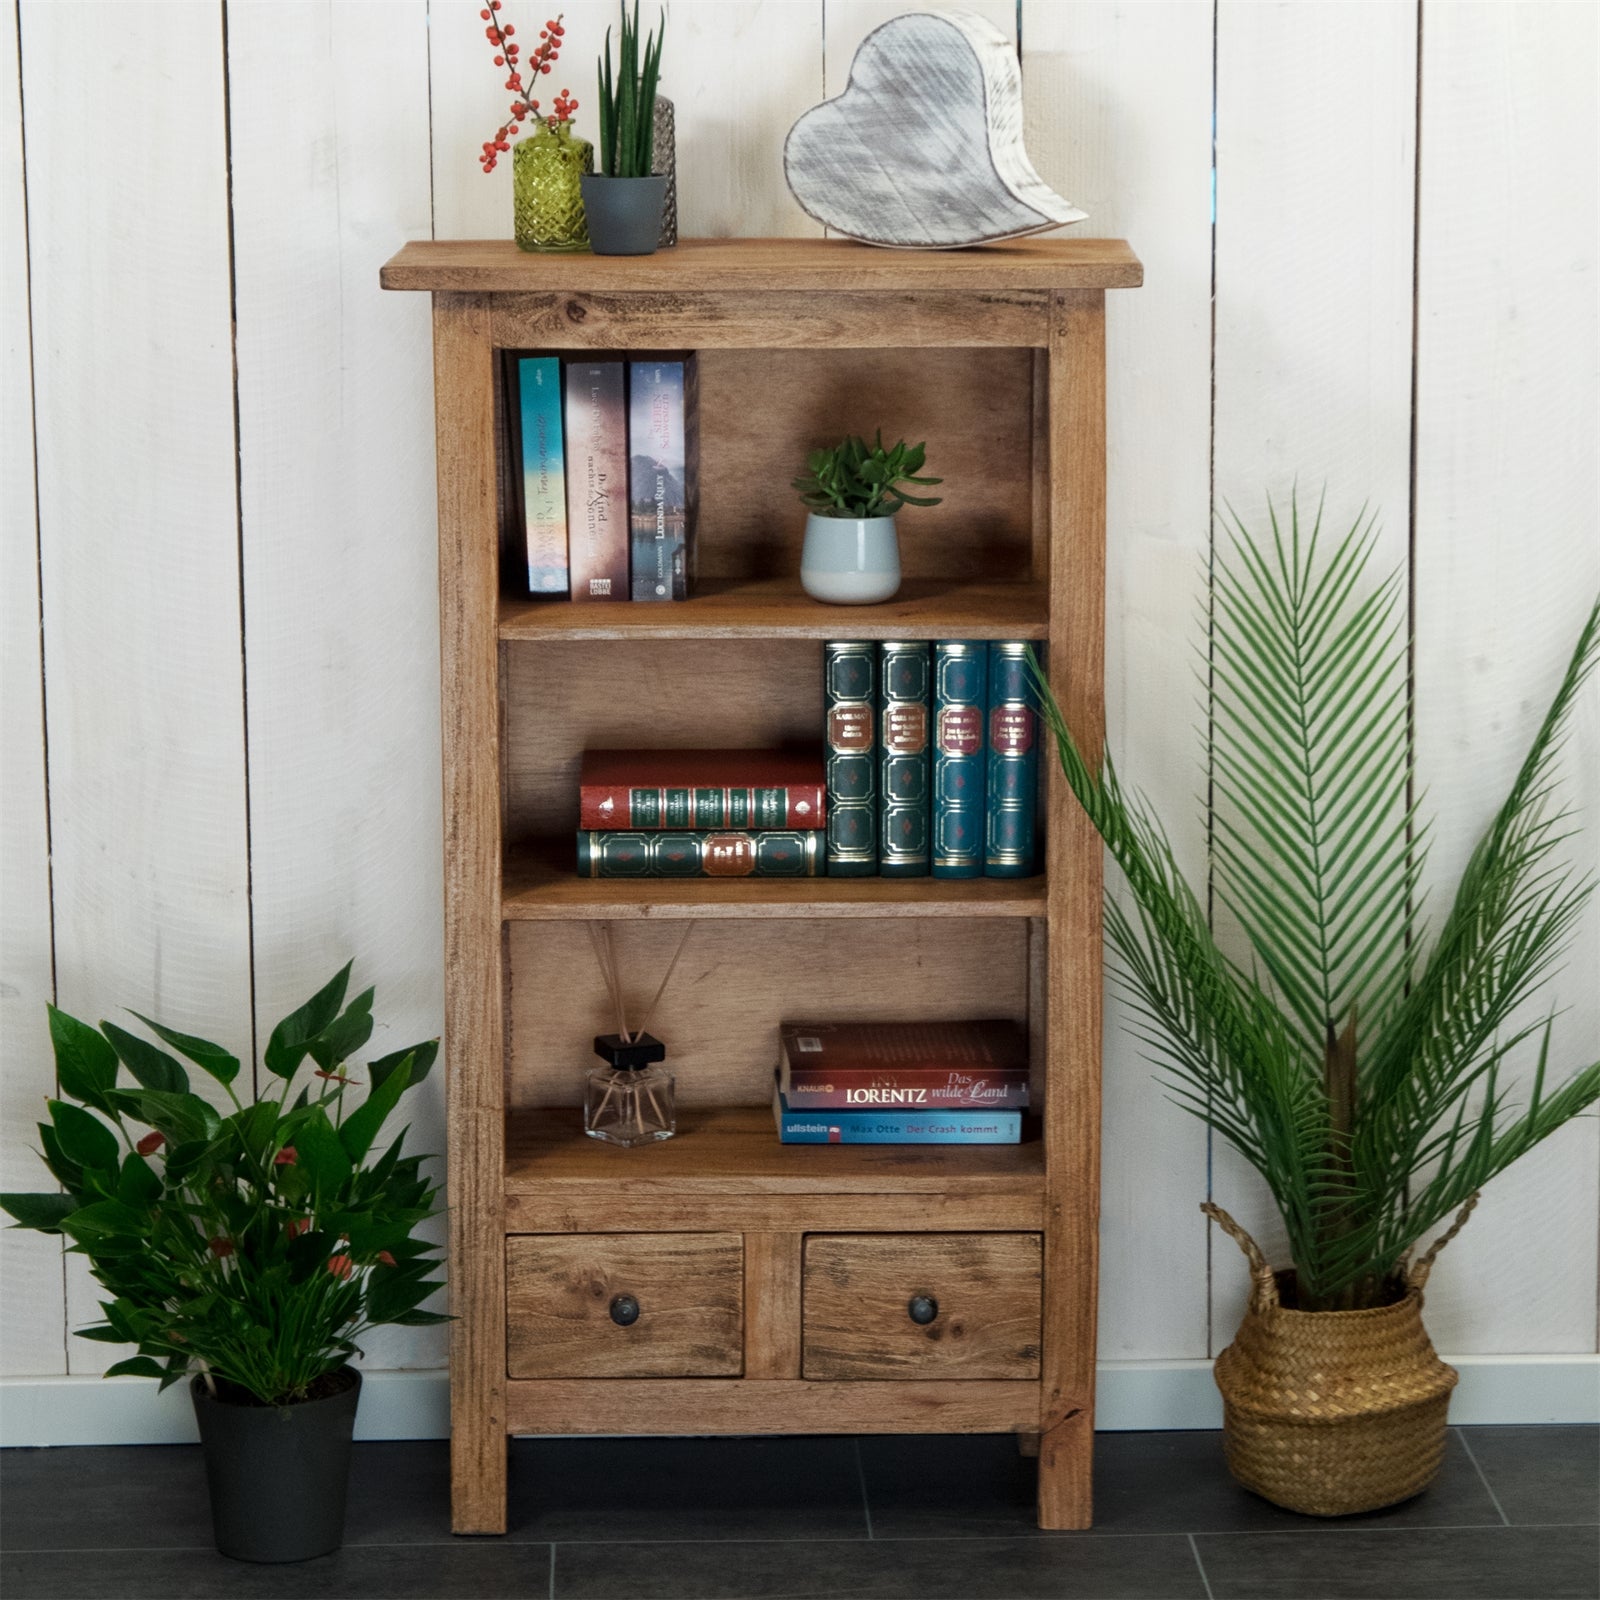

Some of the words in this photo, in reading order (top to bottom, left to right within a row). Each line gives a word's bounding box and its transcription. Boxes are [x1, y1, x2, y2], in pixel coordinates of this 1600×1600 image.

[659, 393, 670, 449] Schwestern
[654, 474, 665, 501] RILEY
[595, 489, 610, 522] Kind
[655, 502, 665, 539] LUCINDA
[948, 1072, 973, 1084] Das
[797, 1085, 825, 1093] KNAUR
[846, 1088, 928, 1103] LORENTZ
[932, 1085, 963, 1098] wilde
[964, 1080, 1008, 1103] Land
[787, 1124, 827, 1133] ullstein
[850, 1125, 873, 1133] Max
[876, 1125, 900, 1133] Otte
[906, 1125, 924, 1133] Der
[928, 1125, 956, 1133] Crash
[961, 1125, 998, 1133] kommt
